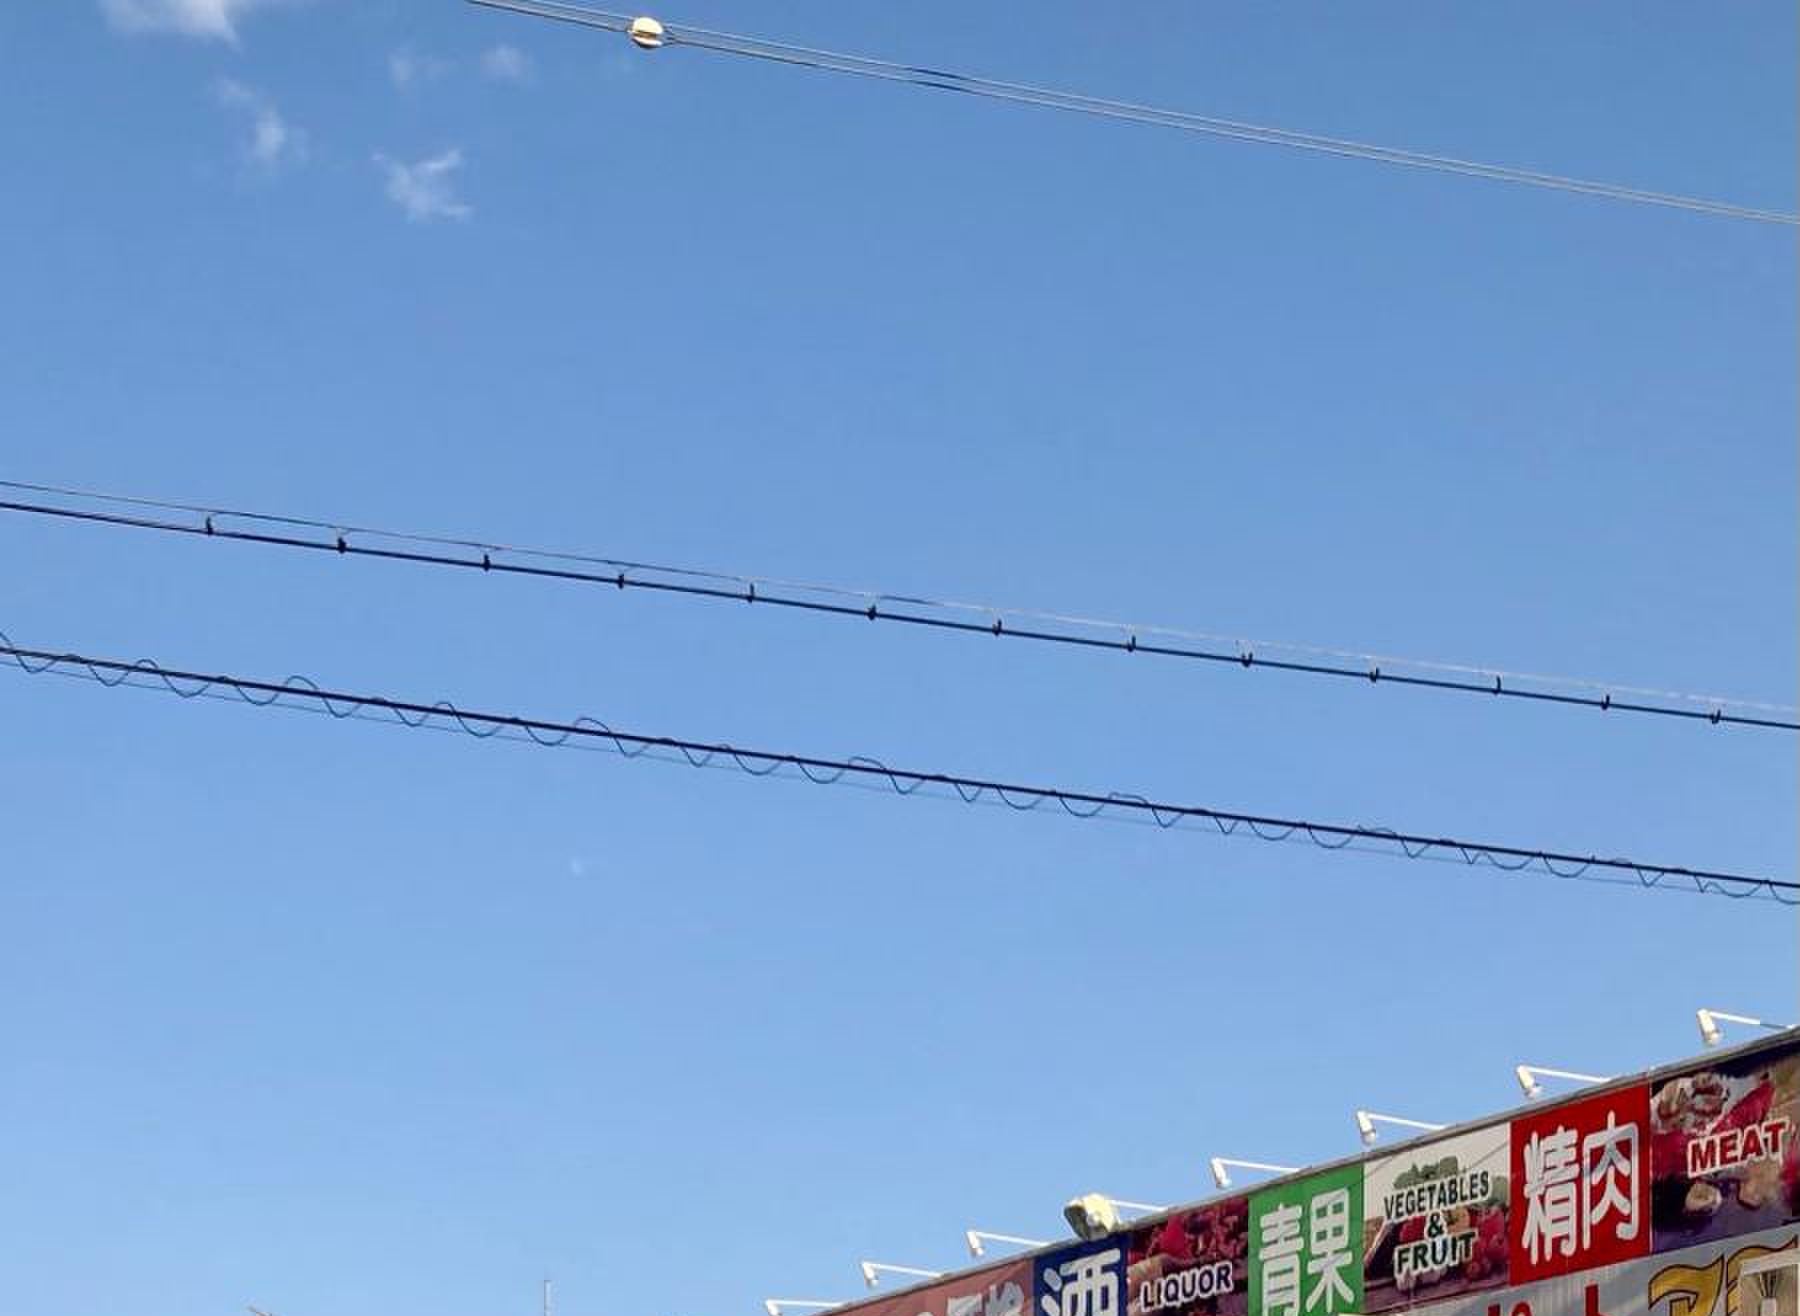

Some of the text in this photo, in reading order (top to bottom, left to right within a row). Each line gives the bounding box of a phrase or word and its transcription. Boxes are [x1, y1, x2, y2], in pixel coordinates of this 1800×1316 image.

[1687, 1118, 1790, 1178] MEAT
[1383, 1170, 1490, 1221] VEGETABLES
[1522, 1111, 1641, 1266] 精肉
[1427, 1211, 1444, 1239] &
[1396, 1230, 1477, 1276] FRUIT
[1140, 1261, 1233, 1311] LIQUOR
